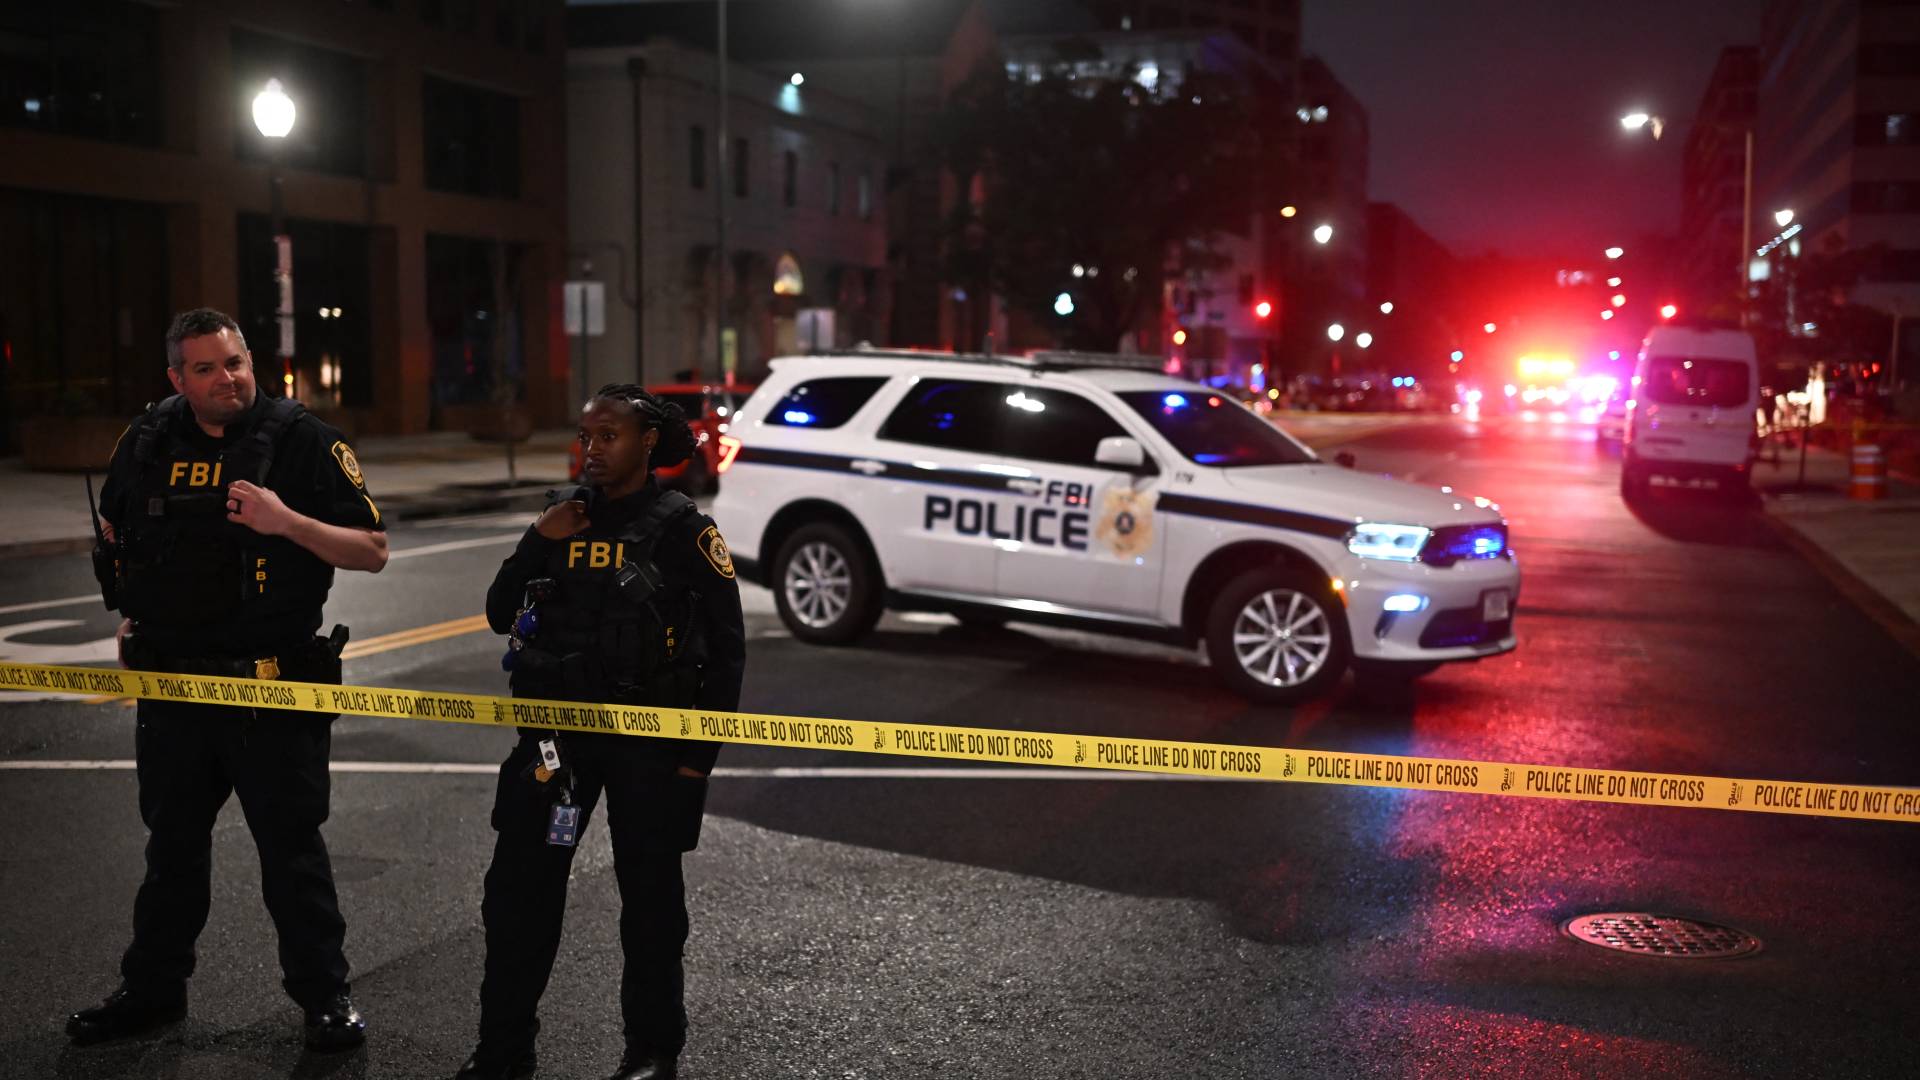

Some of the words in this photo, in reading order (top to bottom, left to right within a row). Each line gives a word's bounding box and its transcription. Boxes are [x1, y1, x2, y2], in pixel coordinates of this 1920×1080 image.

[169, 462, 222, 487] FBI
[1045, 480, 1093, 509] FBI
[924, 494, 1090, 551] POLICE
[568, 541, 624, 569] FBI
[256, 558, 267, 593] FBI
[25, 669, 51, 687] LINE
[49, 670, 66, 688] DO
[66, 672, 87, 690] NOT
[88, 673, 124, 692] CROSS
[157, 679, 195, 698] POLICE
[195, 681, 220, 700] LINE
[219, 683, 237, 701] DO
[238, 685, 260, 703] NOT
[259, 686, 296, 705] CROSS
[331, 691, 370, 711] POLICE
[370, 693, 396, 713] LINE
[396, 695, 413, 715] DO
[412, 696, 435, 716] NOT
[437, 698, 474, 718] CROSS
[512, 704, 552, 724] POLICE
[552, 707, 577, 726] LINE
[578, 709, 596, 728] DO
[597, 709, 620, 729] NOT
[622, 711, 661, 732] CROSS
[700, 717, 740, 737] POLICE
[742, 719, 768, 739] LINE
[770, 721, 787, 741] DO
[789, 722, 812, 742] NOT
[815, 723, 854, 745] CROSS
[895, 729, 936, 751] POLICE
[939, 732, 965, 753] LINE
[968, 734, 984, 754] DO
[987, 735, 1010, 756] NOT
[1014, 737, 1054, 759] CROSS
[1097, 743, 1139, 765] POLICE
[1142, 746, 1169, 767] LINE
[1172, 747, 1189, 768] DO
[1192, 749, 1217, 770] NOT
[1219, 750, 1261, 773] CROSS
[1307, 756, 1351, 778] POLICE
[1354, 760, 1382, 781] LINE
[1386, 762, 1403, 782] DO
[1407, 763, 1432, 784] NOT
[1436, 764, 1479, 787] CROSS
[1526, 770, 1572, 793] POLICE
[1575, 773, 1604, 795] LINE
[1607, 776, 1626, 797] DO
[1629, 777, 1657, 798] NOT
[1659, 779, 1705, 801] CROSS
[1754, 785, 1803, 808] POLICE
[1805, 788, 1837, 810] LINE
[1839, 790, 1859, 812] DO
[1862, 791, 1892, 814] NOT
